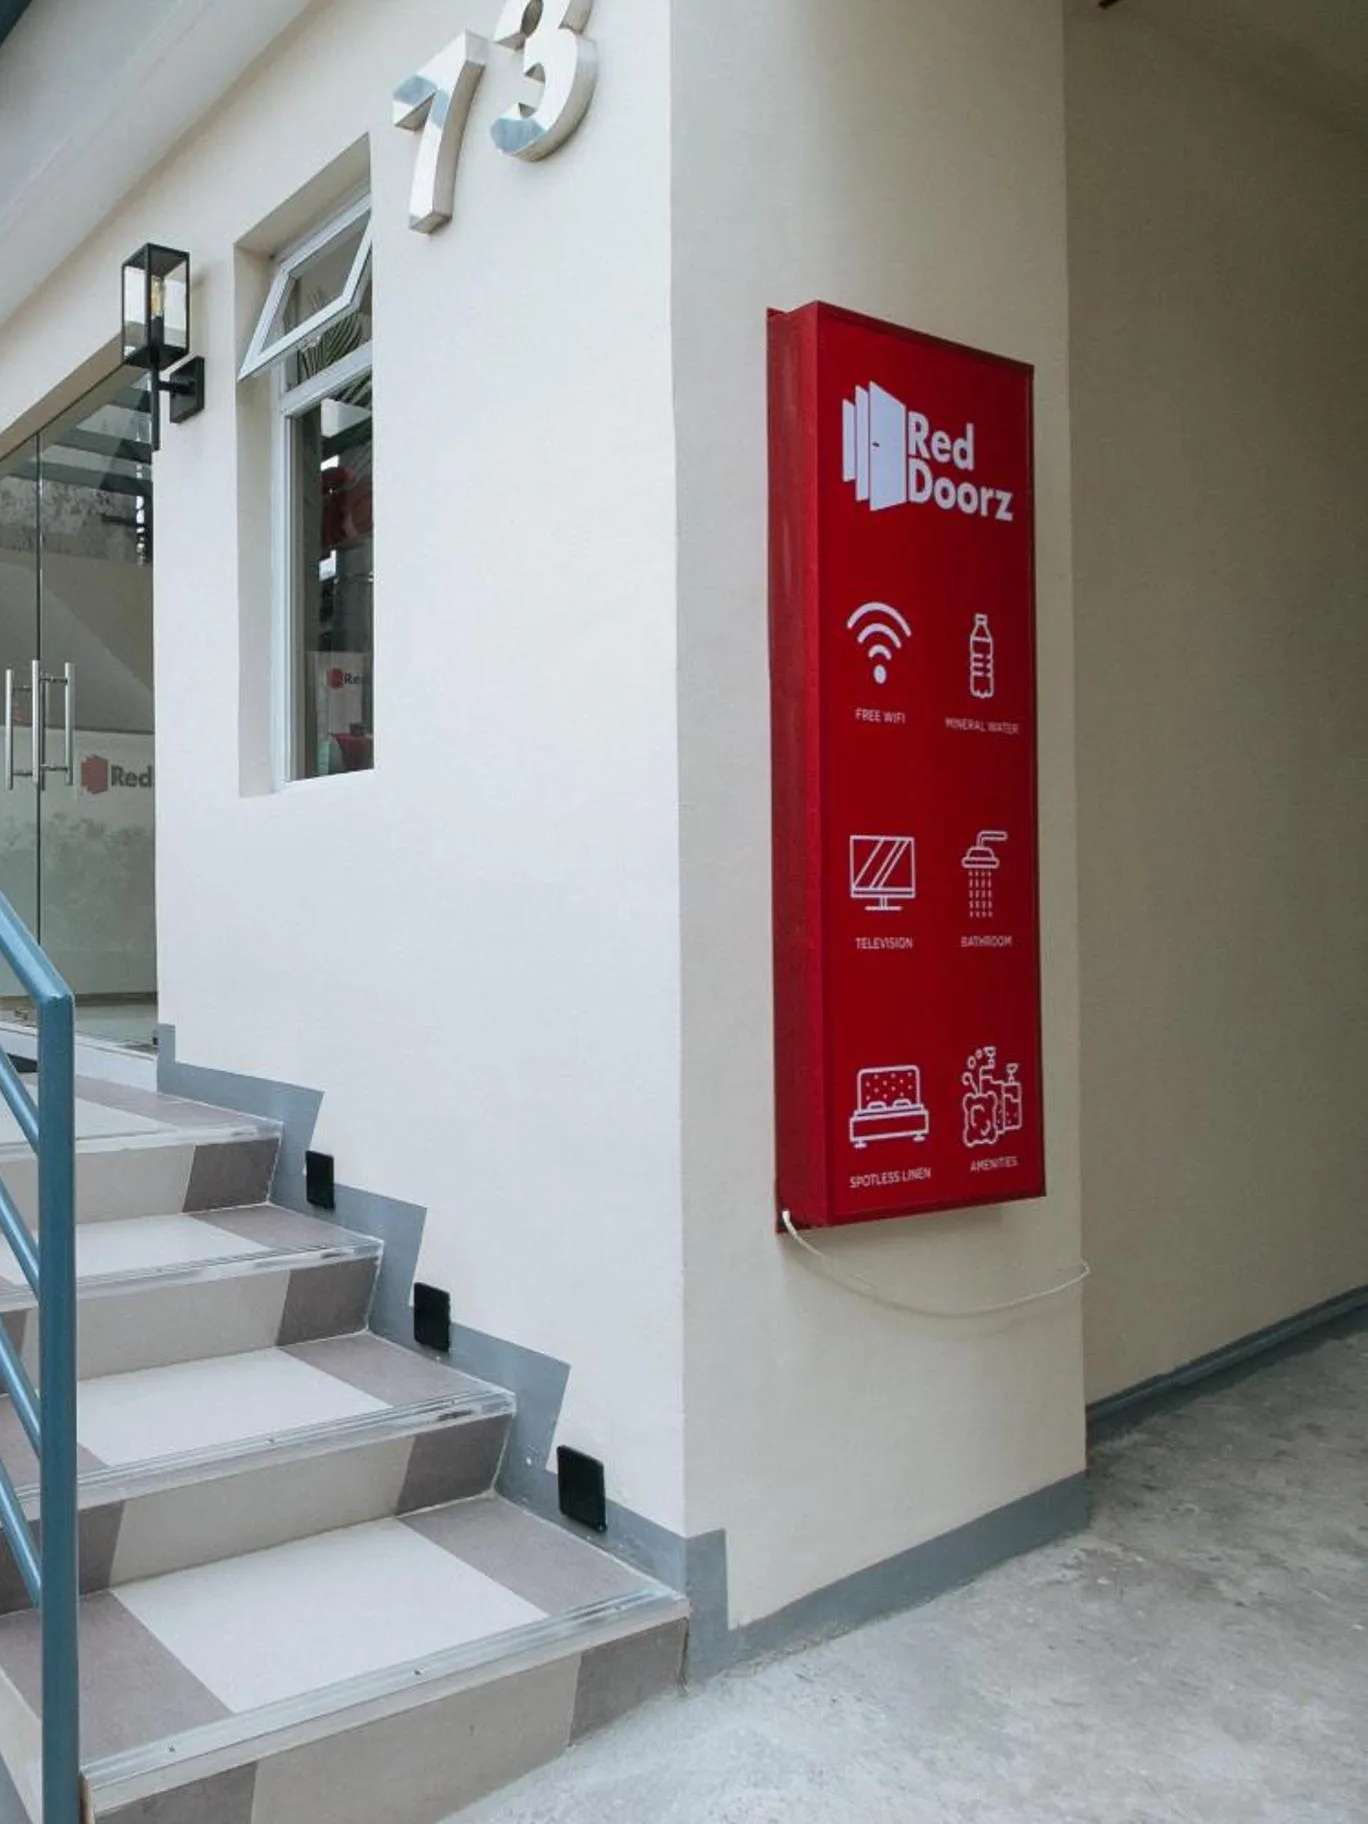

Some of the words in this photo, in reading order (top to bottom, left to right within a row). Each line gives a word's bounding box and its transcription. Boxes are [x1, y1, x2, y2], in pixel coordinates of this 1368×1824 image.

[393, 0, 598, 235] 73
[909, 411, 973, 470] Red
[909, 457, 1012, 521] Doorz
[855, 707, 881, 722] FREE
[884, 711, 906, 724] WIFI
[945, 717, 985, 732] MINERAL
[987, 721, 1019, 735] WATER
[111, 764, 153, 788] Red
[855, 937, 913, 949] TELEVISION
[960, 935, 1013, 948] BATHROOM
[970, 1156, 1019, 1172] AMENITIES
[849, 1169, 900, 1188] SPOTLESS
[902, 1167, 931, 1182] LINEN
